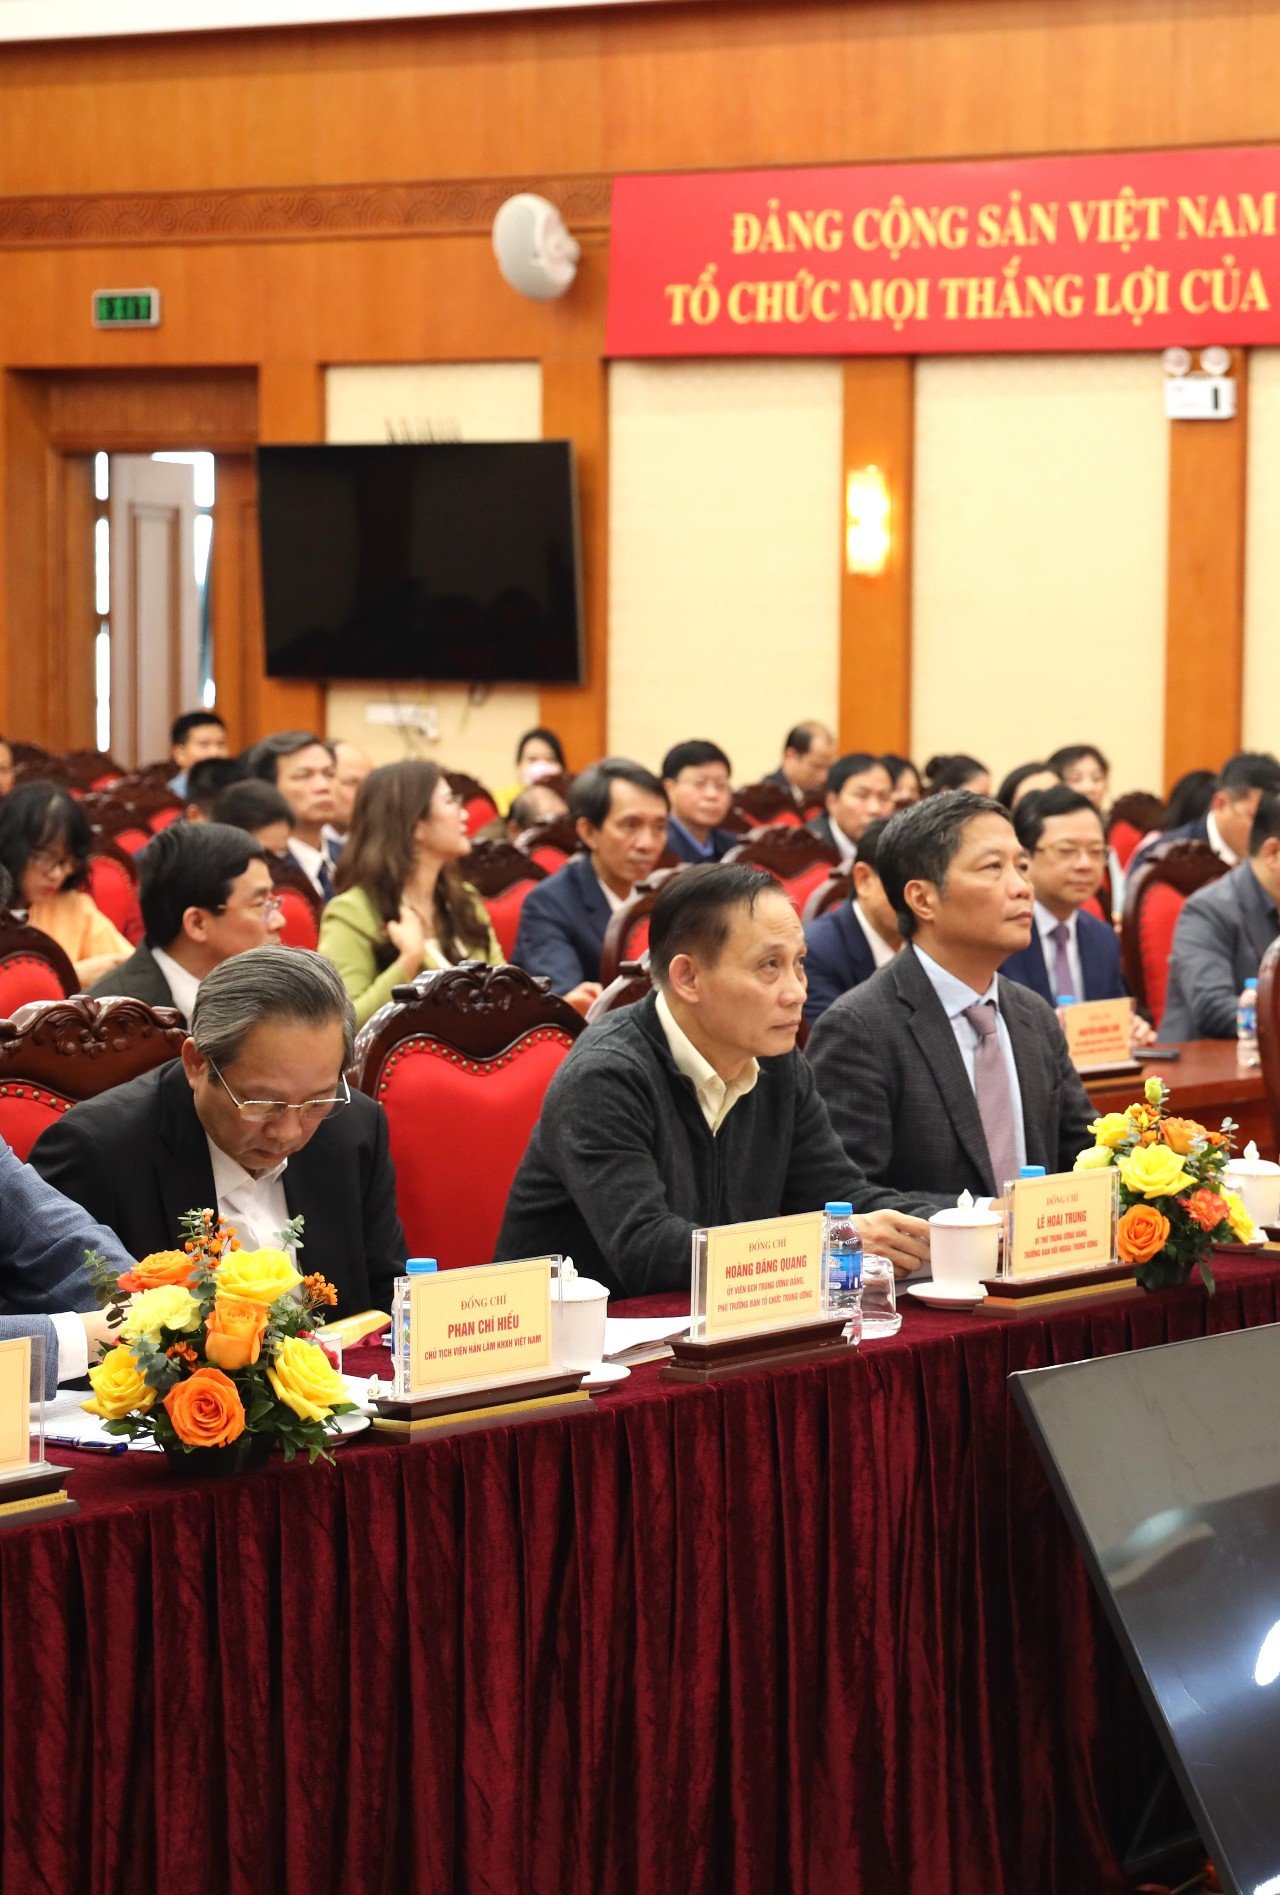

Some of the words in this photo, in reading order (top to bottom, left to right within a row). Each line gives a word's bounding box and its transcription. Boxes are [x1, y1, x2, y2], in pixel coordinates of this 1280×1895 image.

[732, 198, 844, 254] ĐẢNG
[852, 194, 969, 260] CỘNG
[976, 189, 1059, 248] SẢN
[1067, 185, 1169, 253] VIỆT
[1177, 191, 1278, 240] NAM
[665, 261, 721, 325] TỔ
[727, 268, 841, 324] CHỨC
[849, 277, 930, 331] MỌI
[938, 255, 1084, 320] THẮNG
[1094, 264, 1170, 326] LỢI
[1179, 254, 1270, 314] CỦA
[1065, 1210, 1087, 1224] TRUNG
[726, 1262, 753, 1279] HOÀNG
[756, 1259, 778, 1274] ĐĂNG
[780, 1255, 807, 1271] QUANG
[461, 1294, 487, 1311] ĐỒNG
[490, 1292, 507, 1306] CHÍ
[448, 1321, 475, 1338] PHAN
[478, 1315, 494, 1334] CHÍ
[497, 1310, 519, 1331] HIẾU
[425, 1347, 437, 1360] CHỦ
[439, 1348, 452, 1360] TỊCH
[453, 1345, 467, 1357] VIỆN
[469, 1342, 482, 1353] HÀN
[483, 1341, 496, 1352] LÂM
[497, 1339, 513, 1349] KHXH
[514, 1336, 526, 1348] VIỆT
[527, 1334, 542, 1344] NAM
